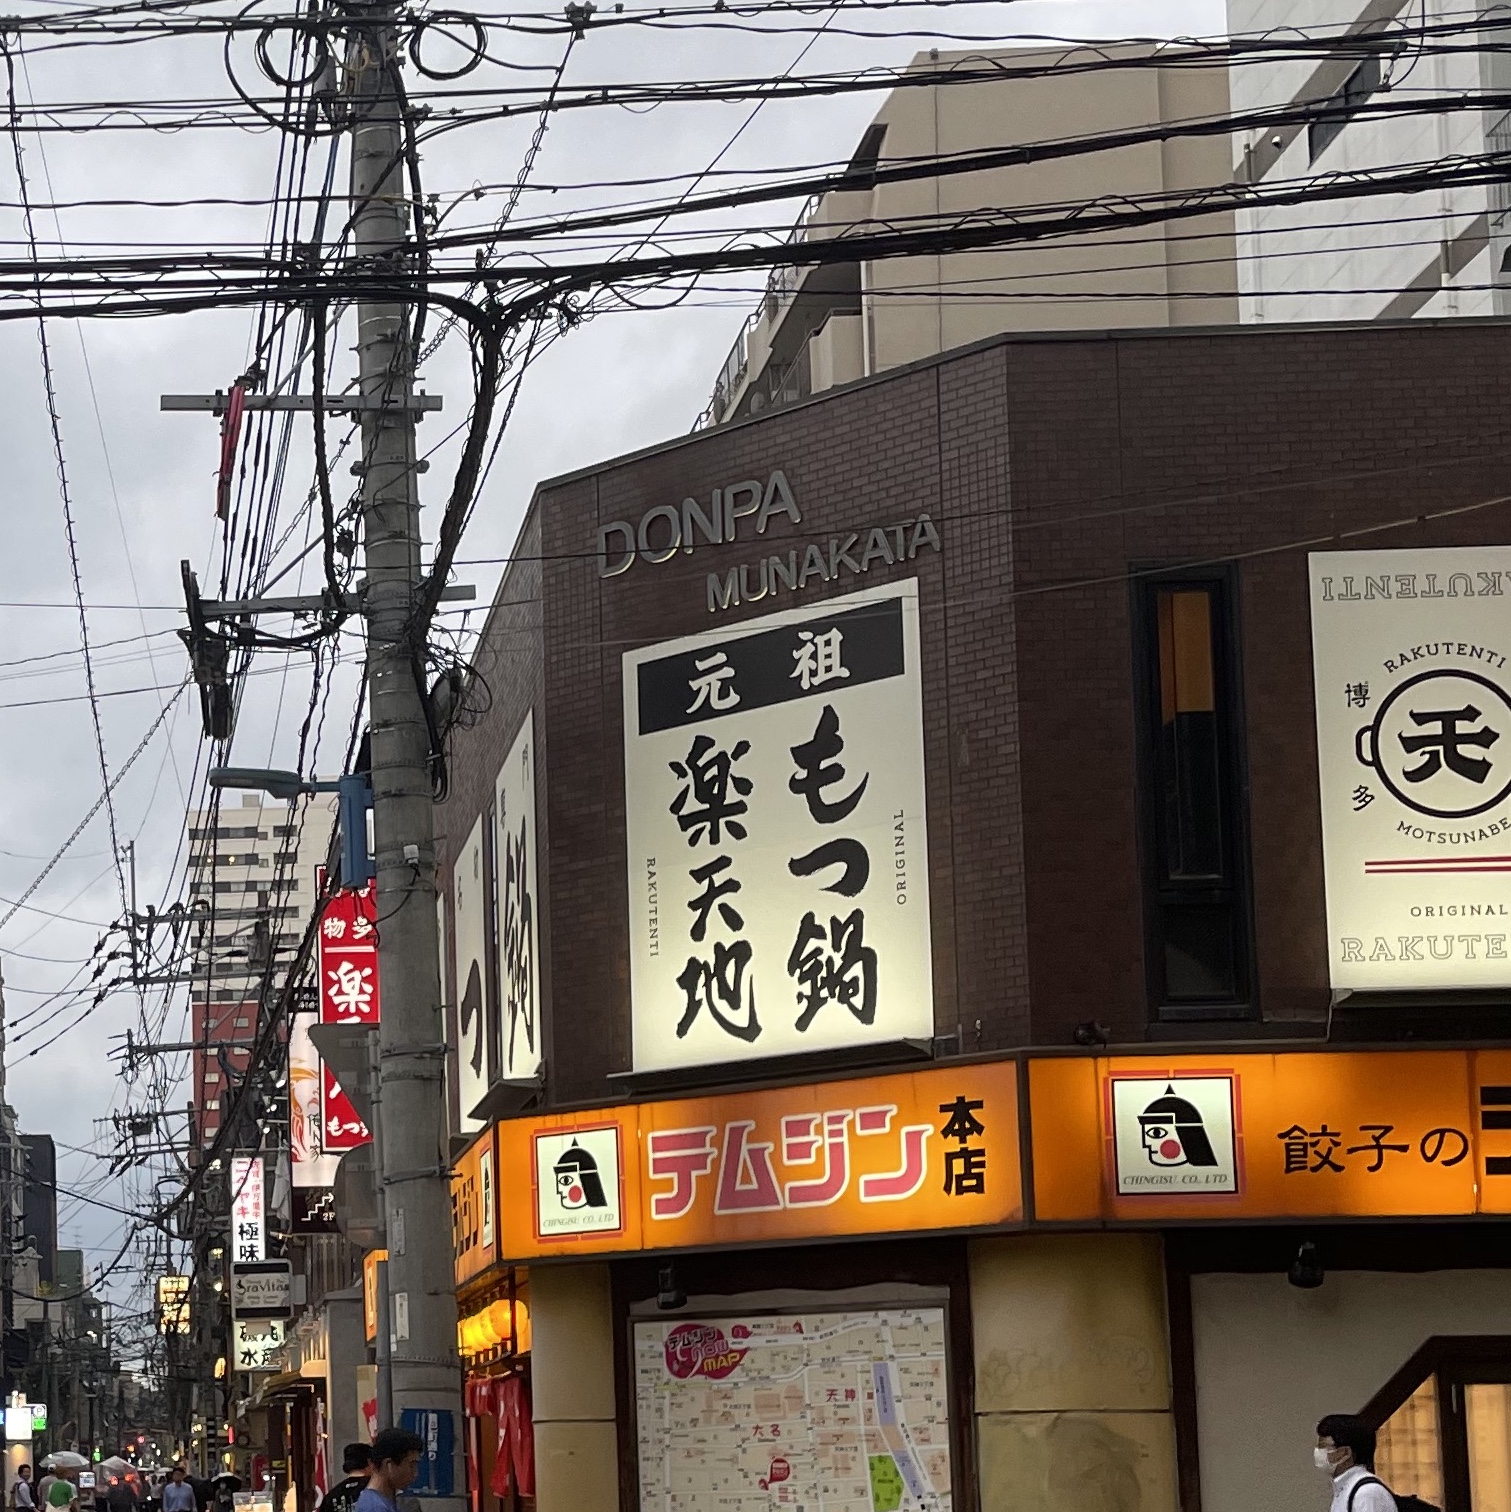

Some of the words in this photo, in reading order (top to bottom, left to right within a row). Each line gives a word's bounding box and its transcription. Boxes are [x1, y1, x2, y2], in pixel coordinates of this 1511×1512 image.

[596, 469, 803, 578] DONPA
[706, 513, 941, 613] MUNAKATA
[1321, 571, 1511, 601] KUTENTI
[685, 627, 851, 714] 元祖
[1383, 642, 1507, 673] RAKUTENTI
[788, 704, 878, 1033] もつ鍋
[894, 808, 905, 905] ORIGINAL
[1396, 817, 1511, 845] MOTSUNABE
[645, 857, 660, 958] RAKUTENTI
[669, 734, 763, 1044] 楽天地
[1410, 904, 1509, 917] ORIGINAL
[1340, 933, 1511, 963] RAKUTE
[647, 1104, 934, 1221] テムジン
[939, 1095, 986, 1198] 本店
[1276, 1124, 1470, 1174] 餃子の
[703, 1352, 740, 1372] MAP
